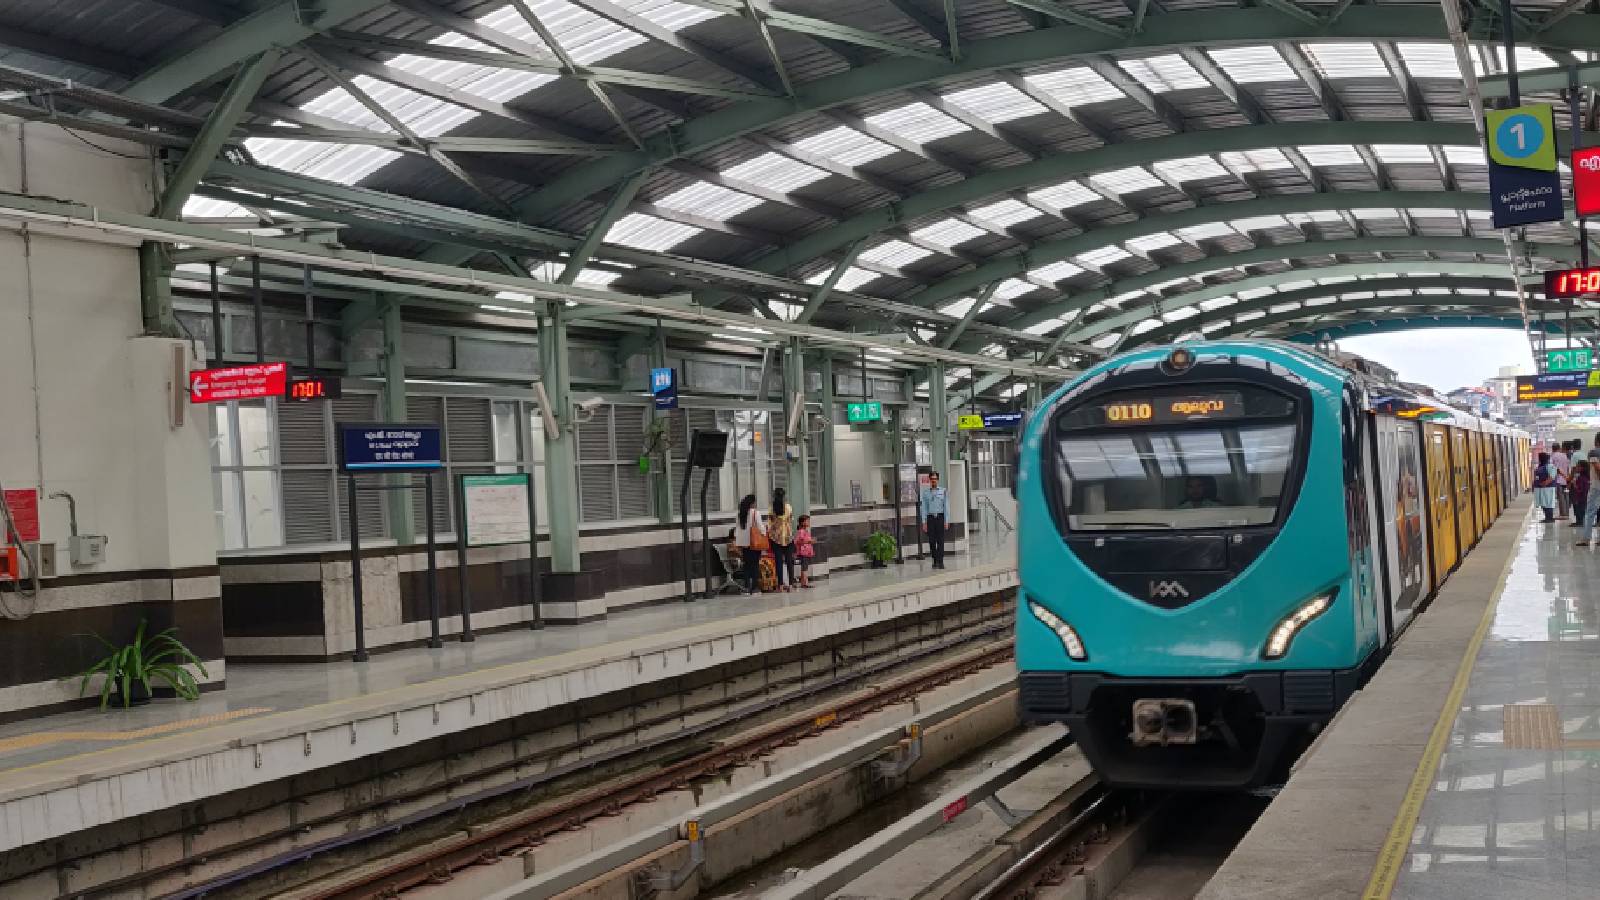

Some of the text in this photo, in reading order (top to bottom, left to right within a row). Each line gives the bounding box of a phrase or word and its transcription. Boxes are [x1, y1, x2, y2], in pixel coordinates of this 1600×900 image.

[1510, 122, 1526, 150] 1
[1509, 200, 1546, 213] Platform
[292, 382, 322, 397] 17:01
[1108, 403, 1152, 420] 0110
